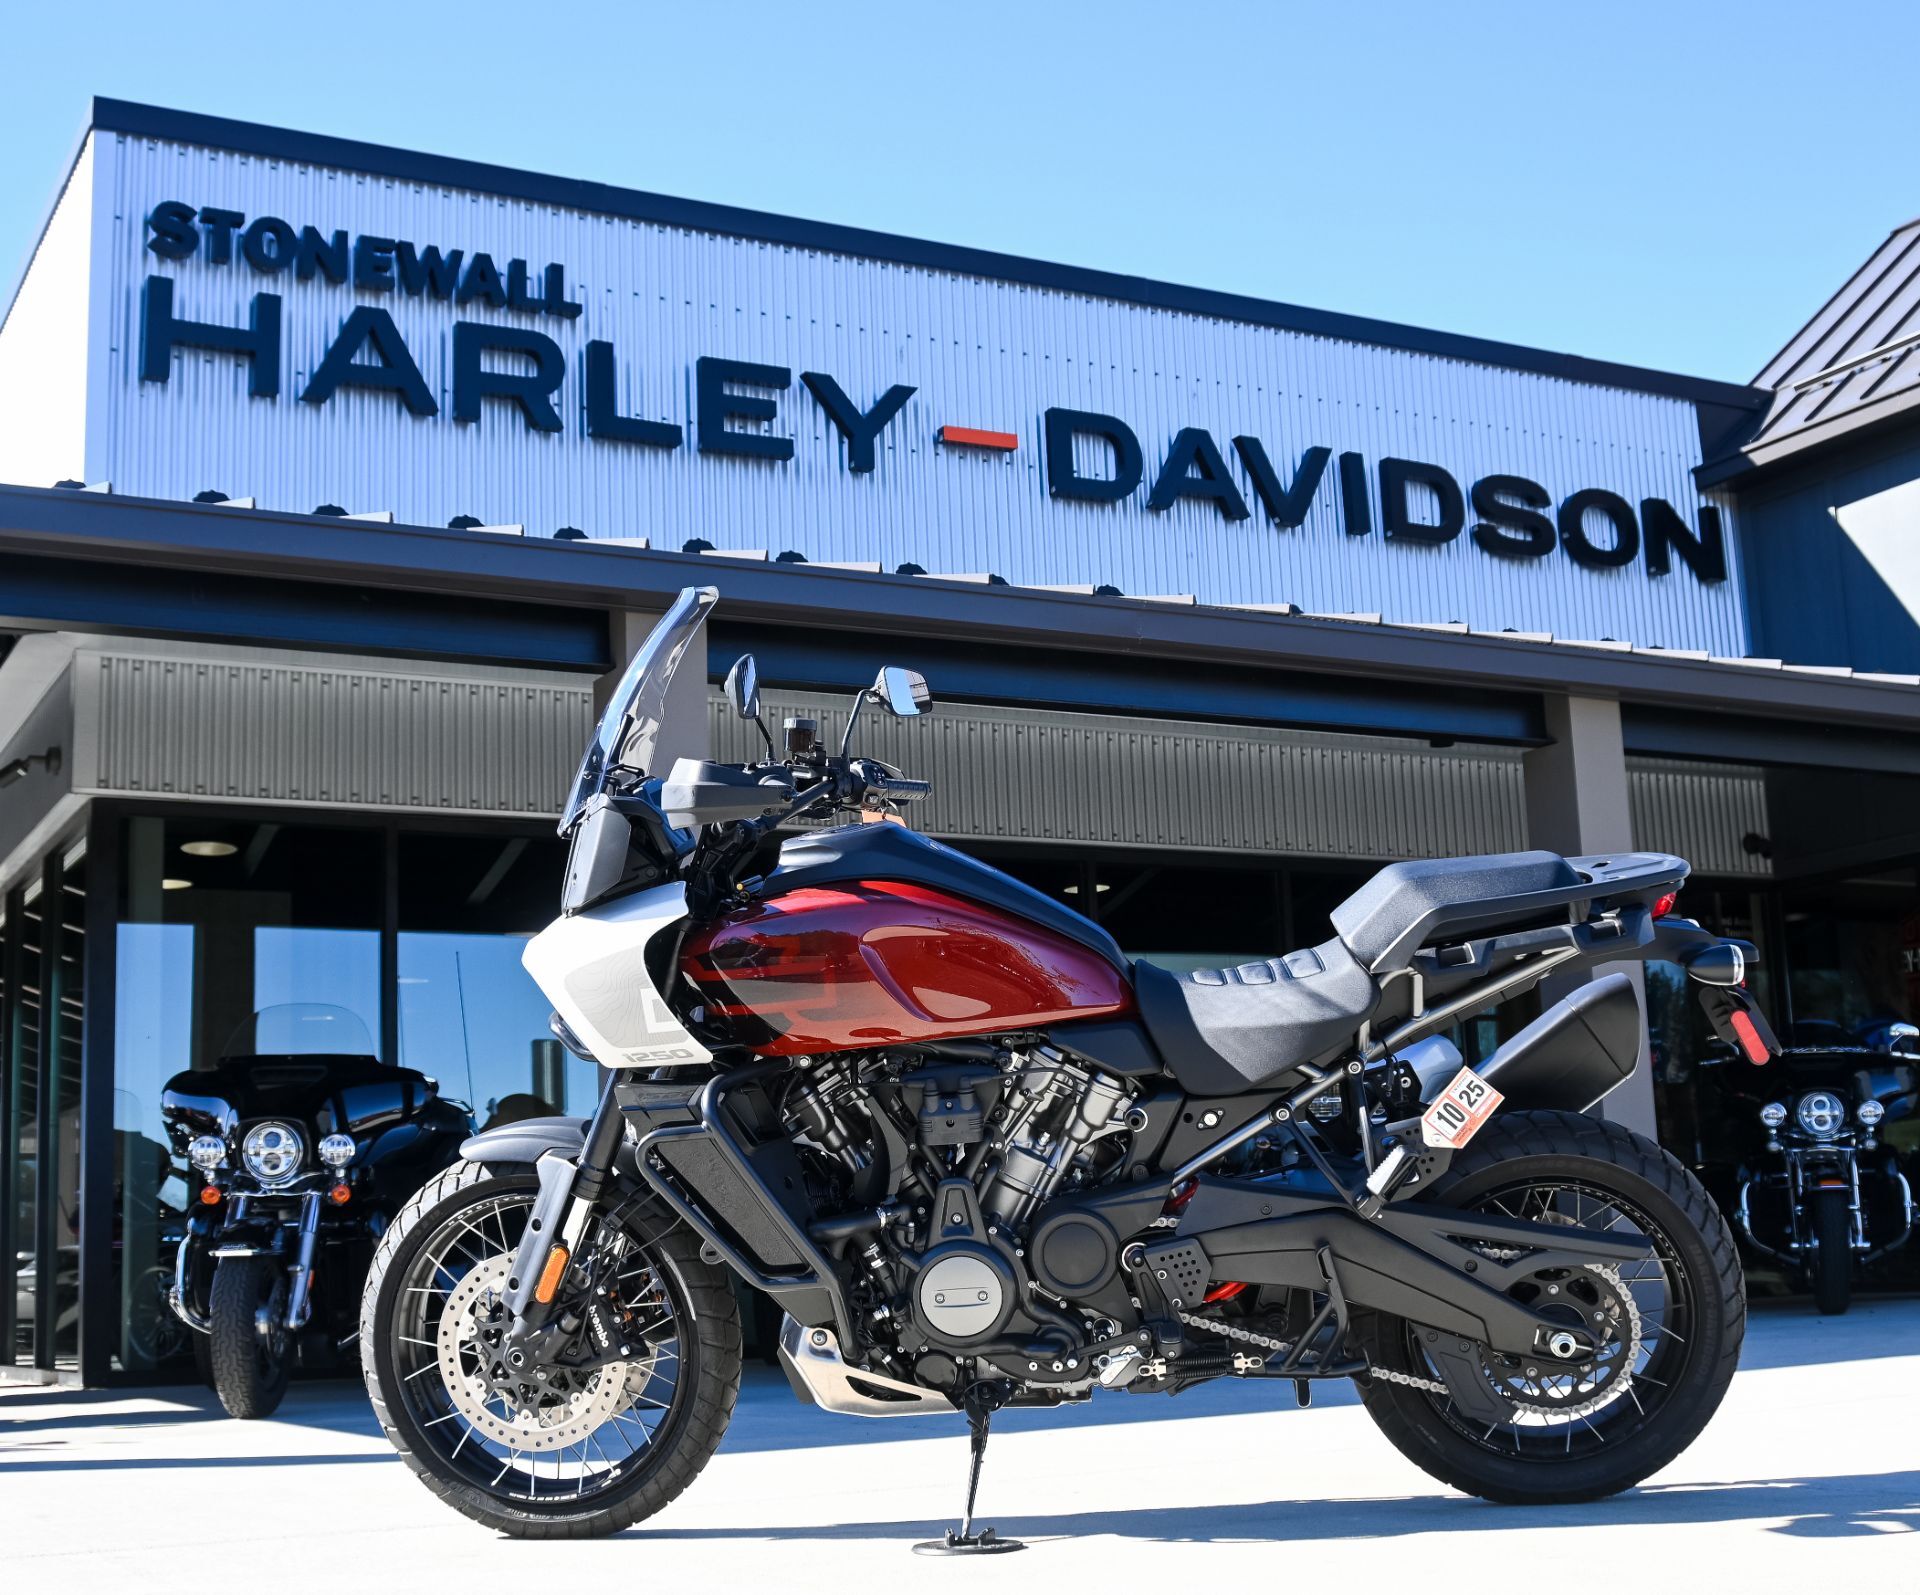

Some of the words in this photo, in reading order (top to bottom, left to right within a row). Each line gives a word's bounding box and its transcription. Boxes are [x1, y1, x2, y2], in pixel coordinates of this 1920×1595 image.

[146, 200, 583, 319] STONEWALL
[622, 1048, 694, 1063] 1250
[1437, 1102, 1466, 1131] 10
[1459, 1079, 1485, 1109] 25
[589, 1304, 609, 1348] brembo
